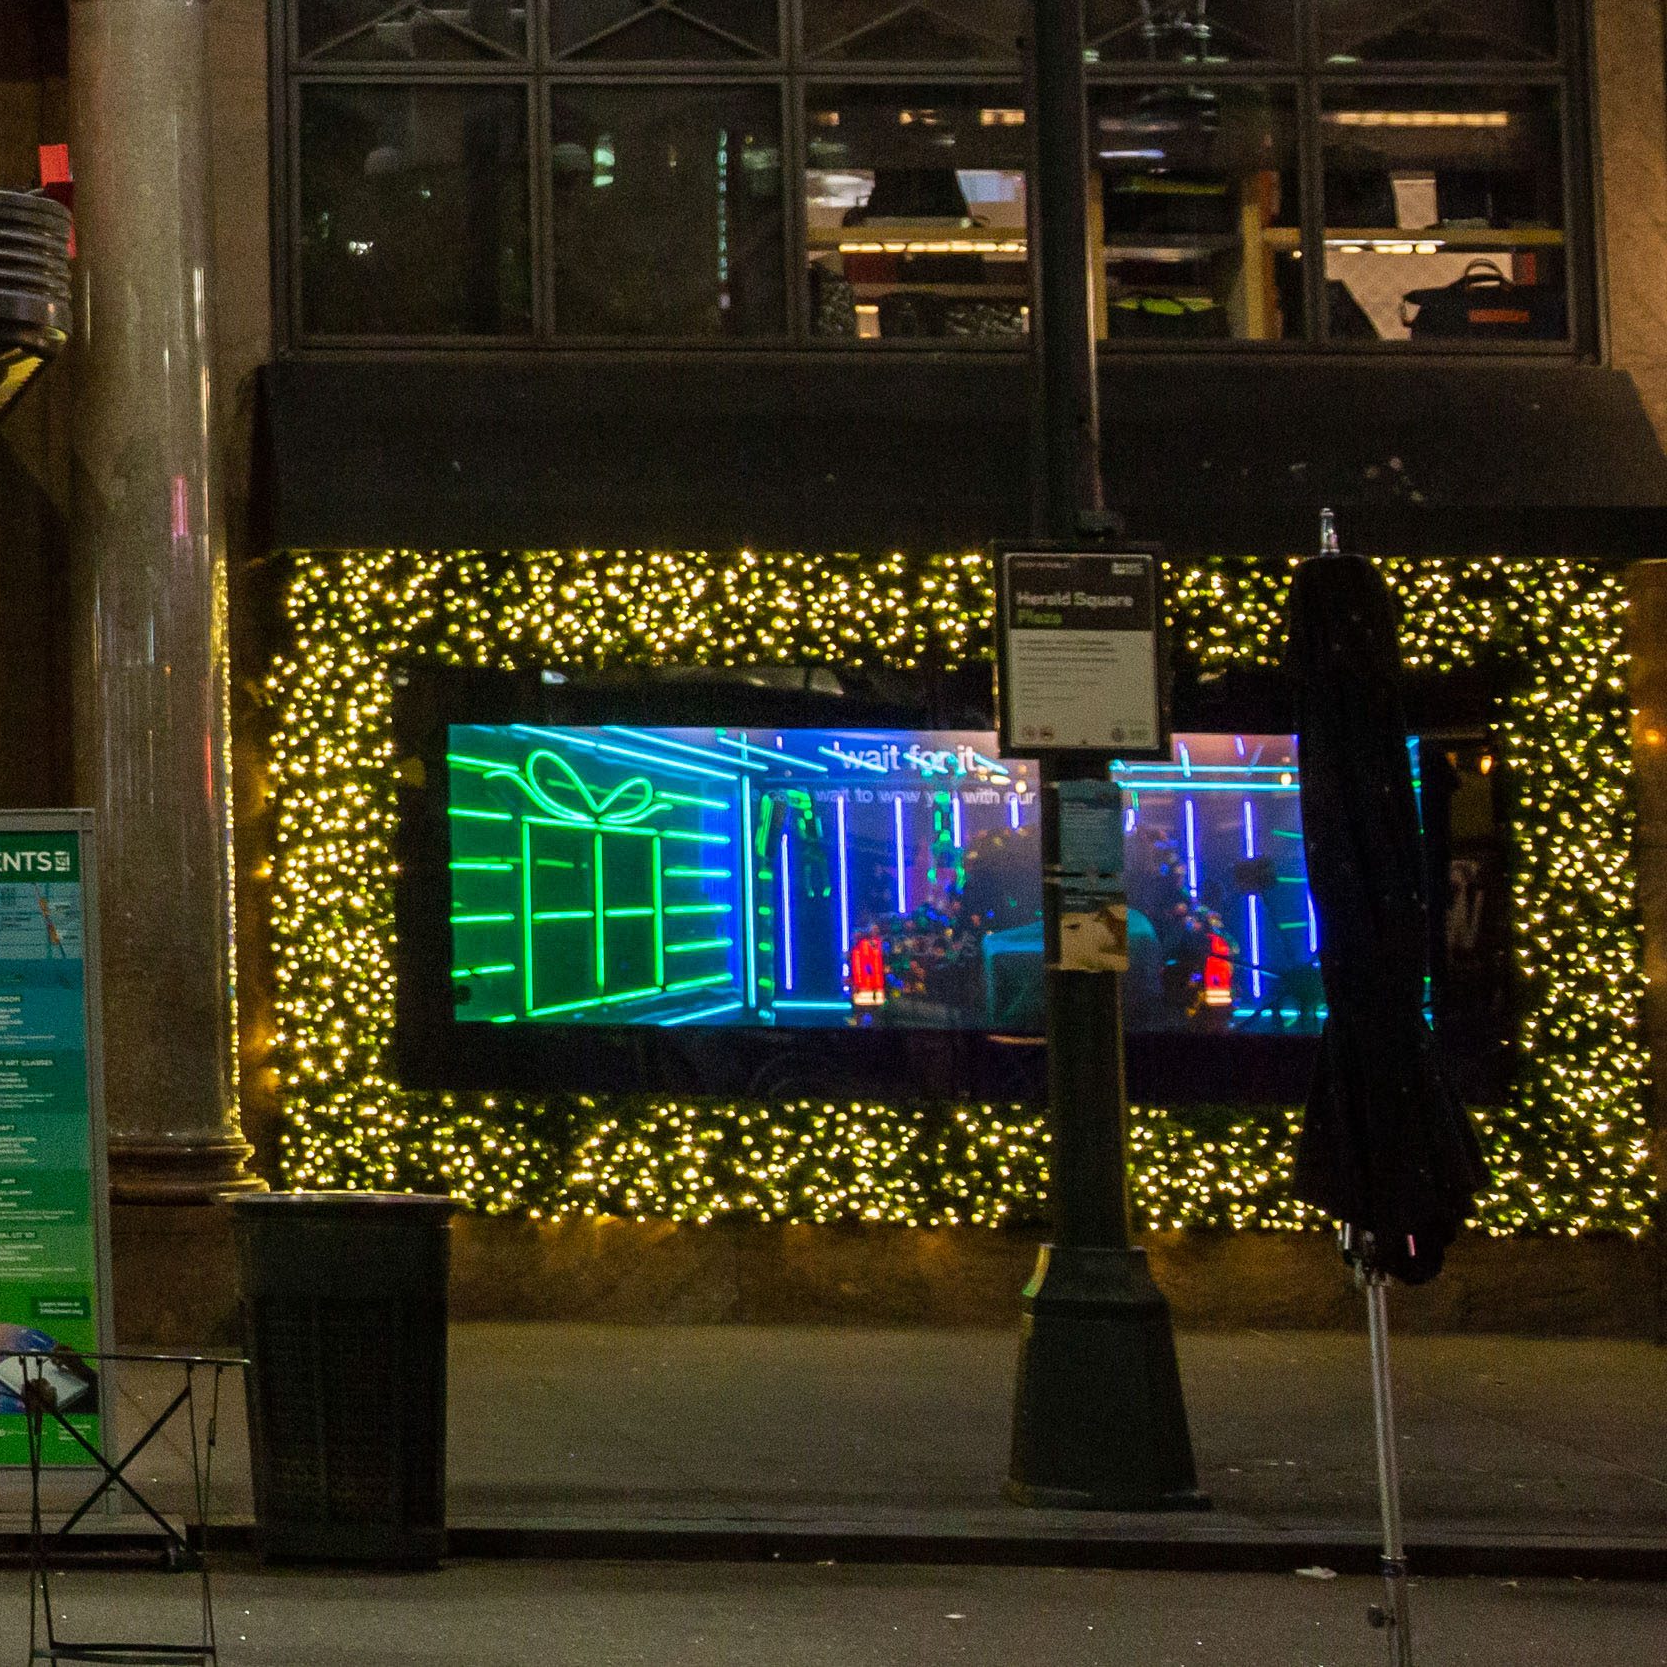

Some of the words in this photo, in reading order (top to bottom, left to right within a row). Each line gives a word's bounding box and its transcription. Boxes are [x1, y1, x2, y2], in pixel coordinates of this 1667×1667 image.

[839, 744, 901, 771] wait
[854, 787, 874, 803] to
[962, 788, 1001, 804] with
